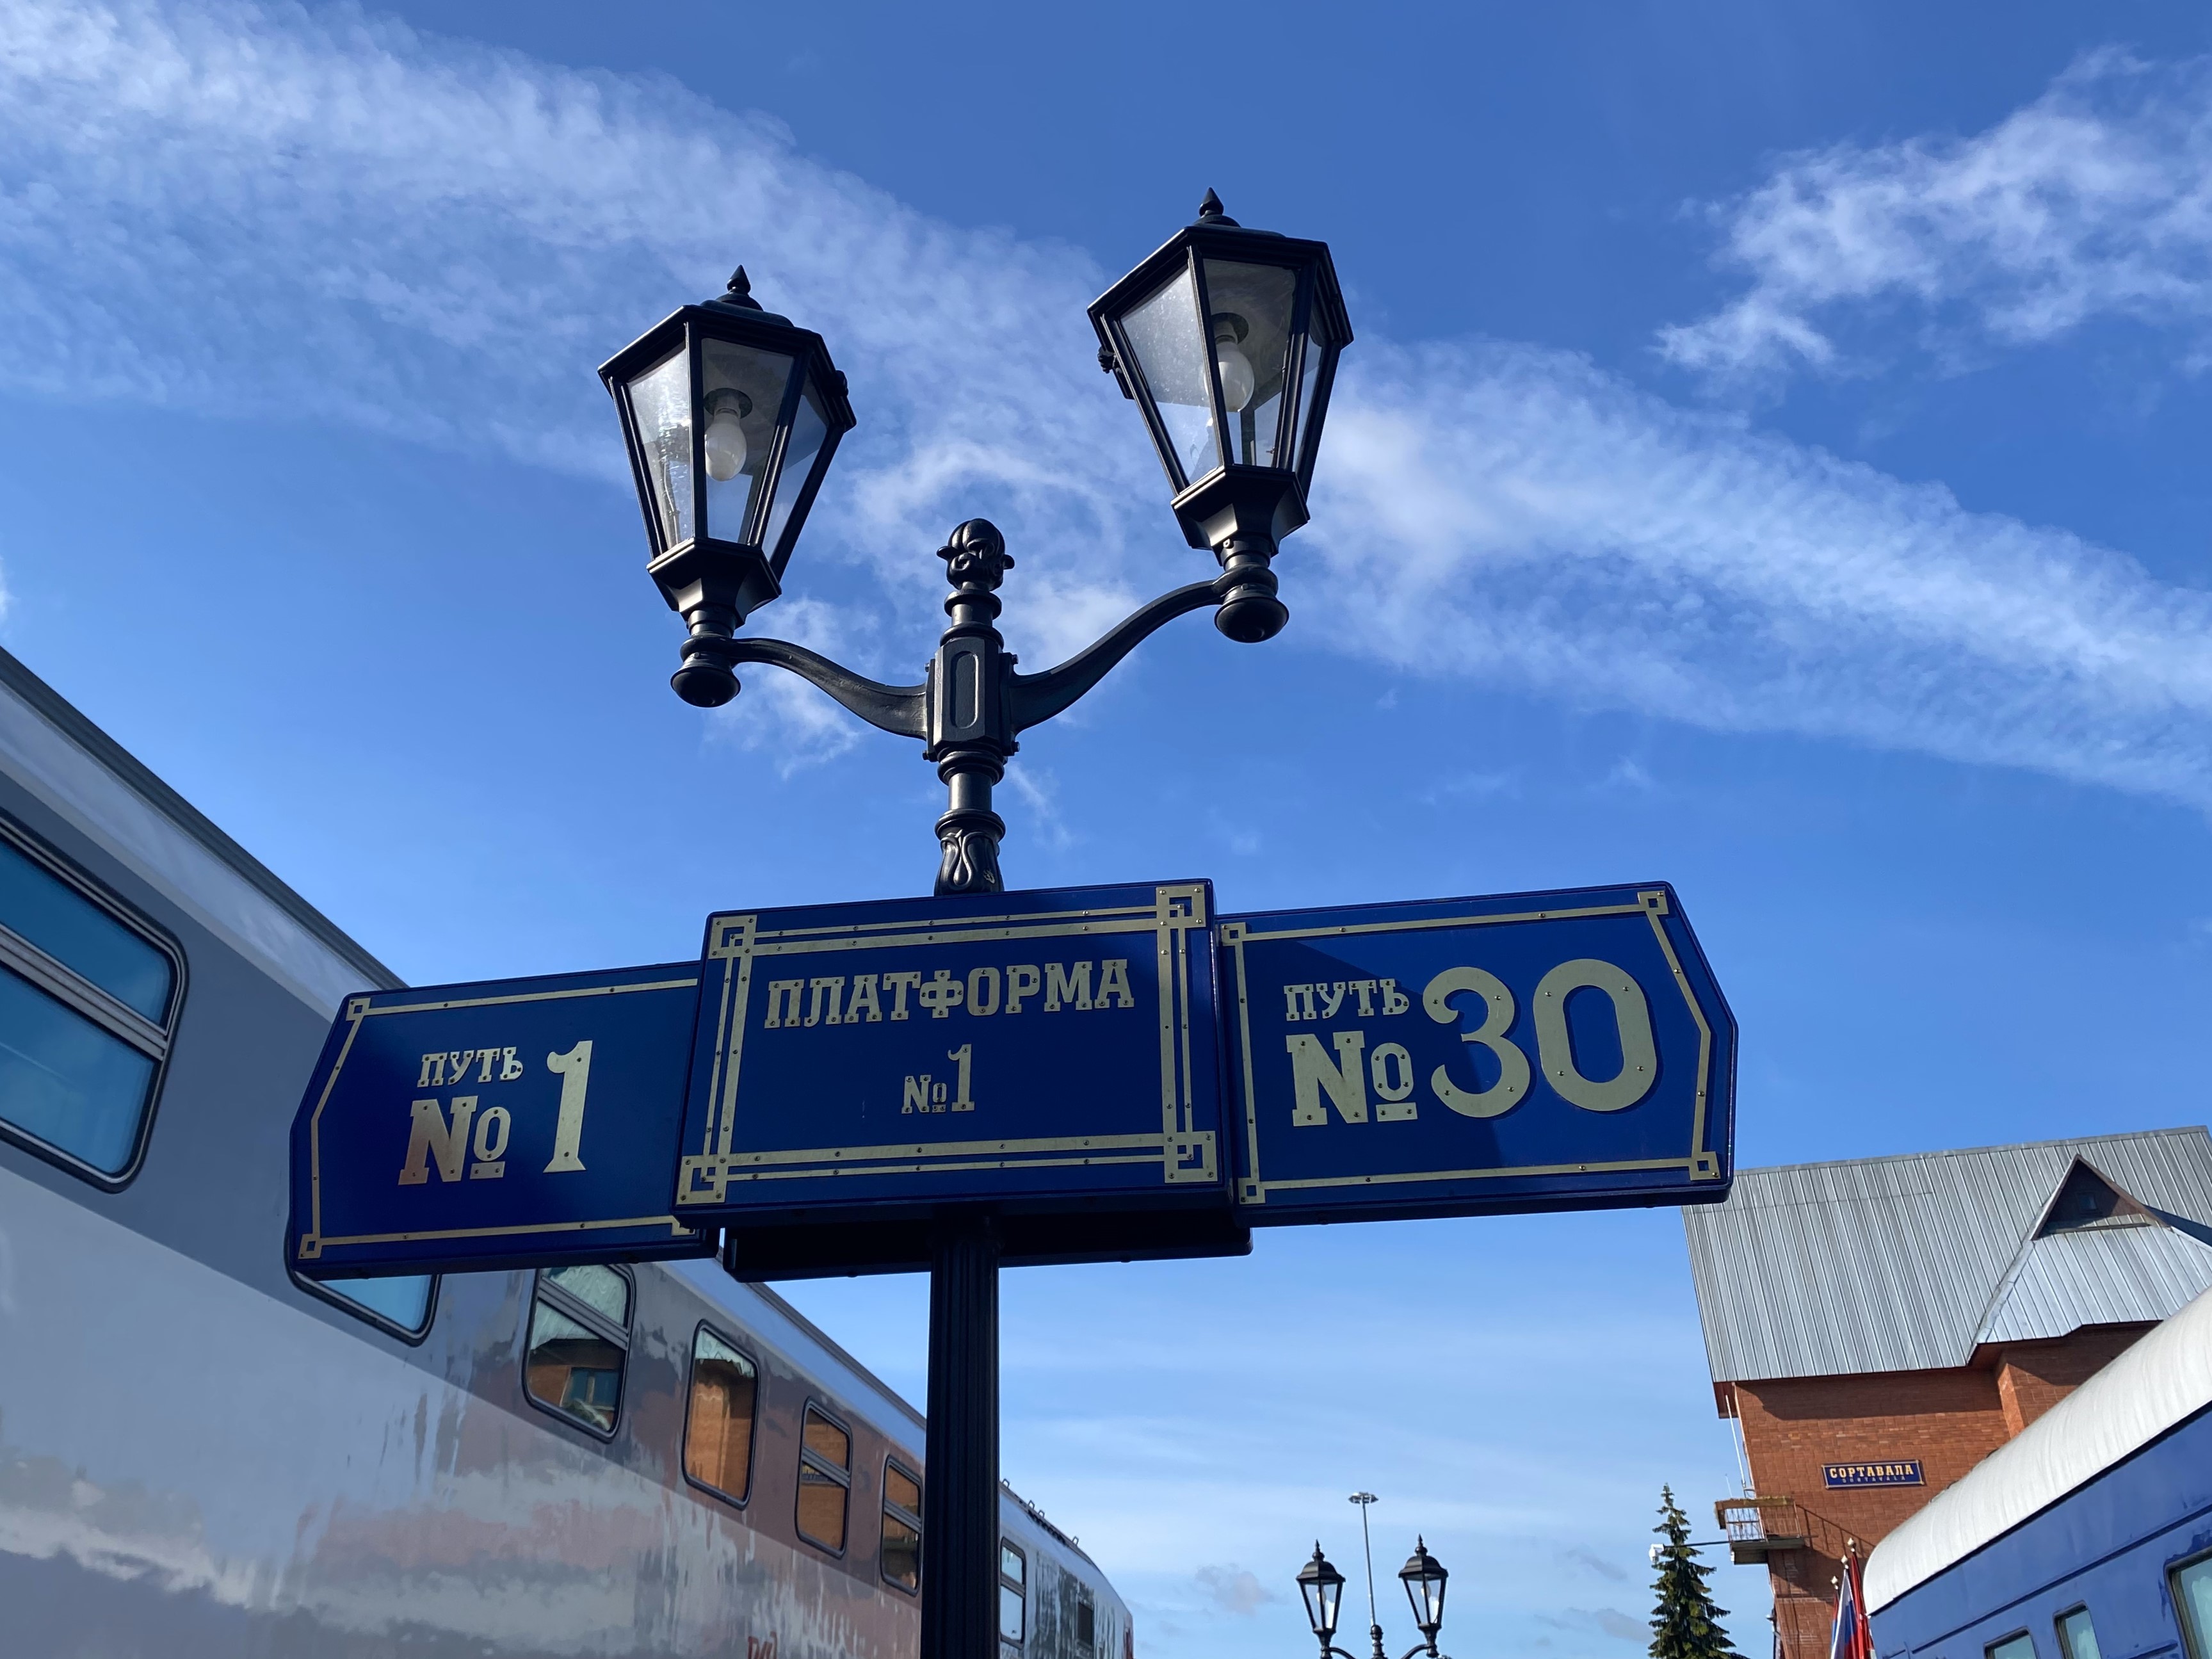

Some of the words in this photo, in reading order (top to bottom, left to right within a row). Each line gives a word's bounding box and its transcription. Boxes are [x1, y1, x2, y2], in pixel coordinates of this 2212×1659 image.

[764, 959, 1134, 1029] ПЛАТФОРМА
[1284, 978, 1410, 1021] ПУТЬ
[417, 1046, 523, 1087] ПУТЬ
[1829, 1464, 1914, 1478] СОРТАВАЛА
